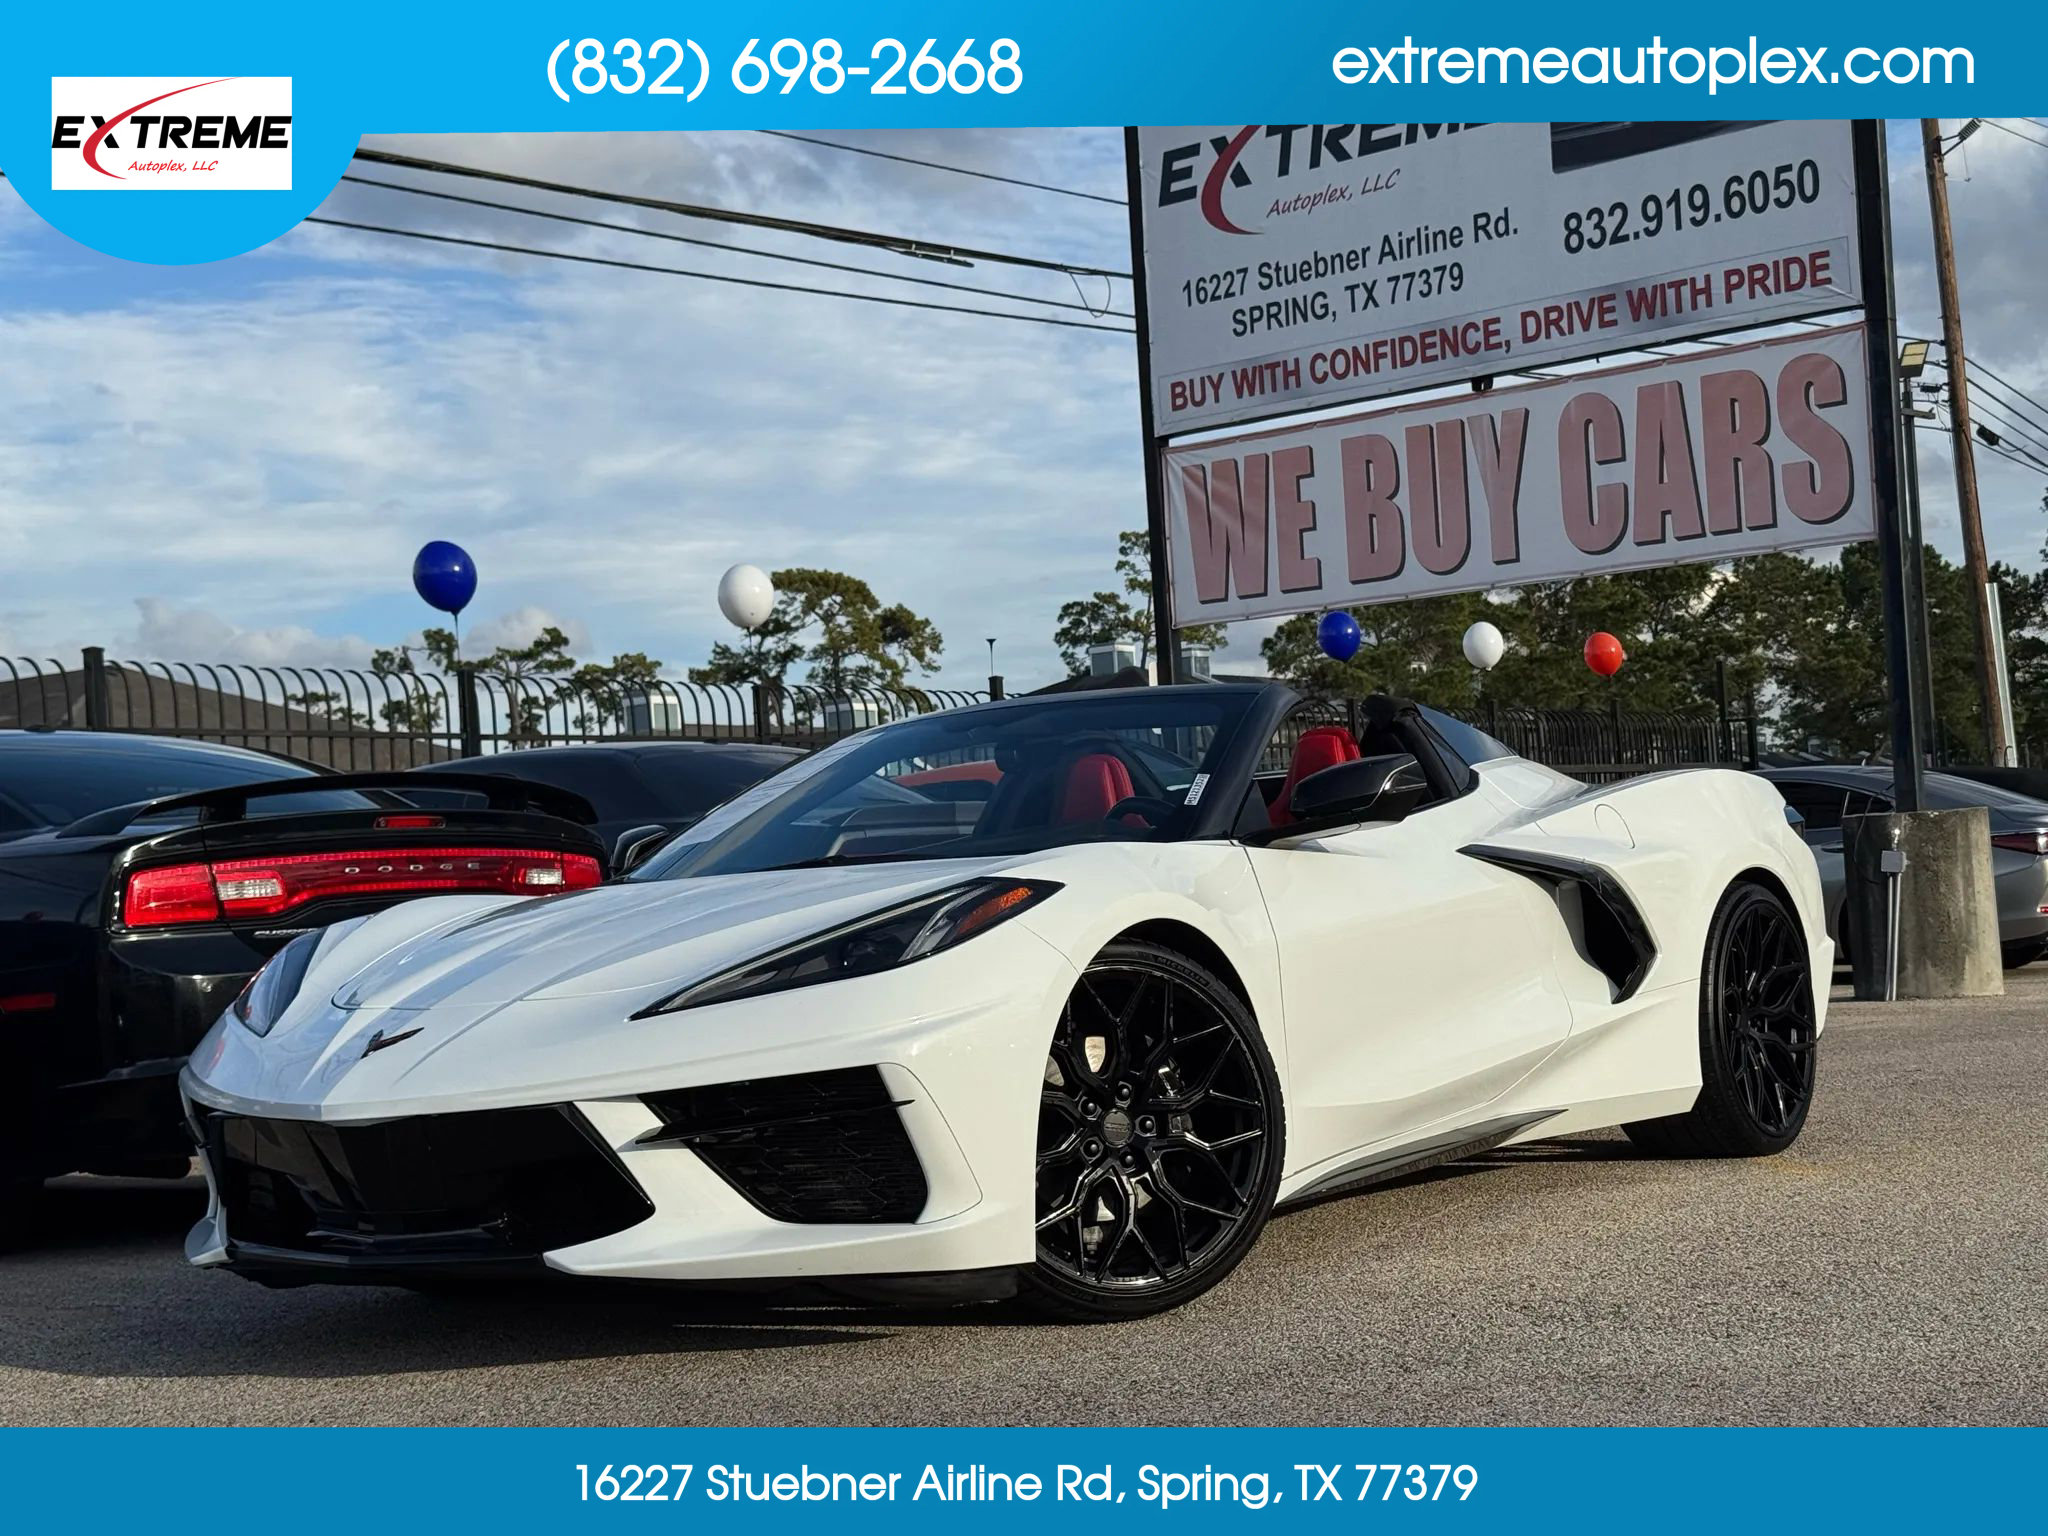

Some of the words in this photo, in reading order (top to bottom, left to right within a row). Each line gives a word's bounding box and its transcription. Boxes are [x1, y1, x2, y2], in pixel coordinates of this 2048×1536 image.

[1266, 183, 1353, 218] Autoplex,
[1361, 169, 1400, 196] LLC
[1563, 159, 1820, 254] 832.919.6050
[1182, 268, 1249, 307] 16227
[1257, 245, 1371, 291] Stuebner
[1378, 225, 1463, 265] Airline
[1473, 207, 1519, 244] Rd.
[1232, 291, 1336, 337] SPRING,
[1345, 279, 1380, 313] TX
[1387, 262, 1464, 305] 77379
[1170, 372, 1224, 412] BUY
[1231, 357, 1301, 399] WITH
[1309, 316, 1511, 385] CONFIDENCE,
[1520, 293, 1618, 344] DRIVE
[1626, 273, 1712, 322] WITH
[1724, 250, 1832, 304] PRIDE
[1182, 445, 1322, 604] WE
[1340, 408, 1530, 586] BUY
[1557, 353, 1854, 555] CARS
[344, 862, 481, 874] DODGE
